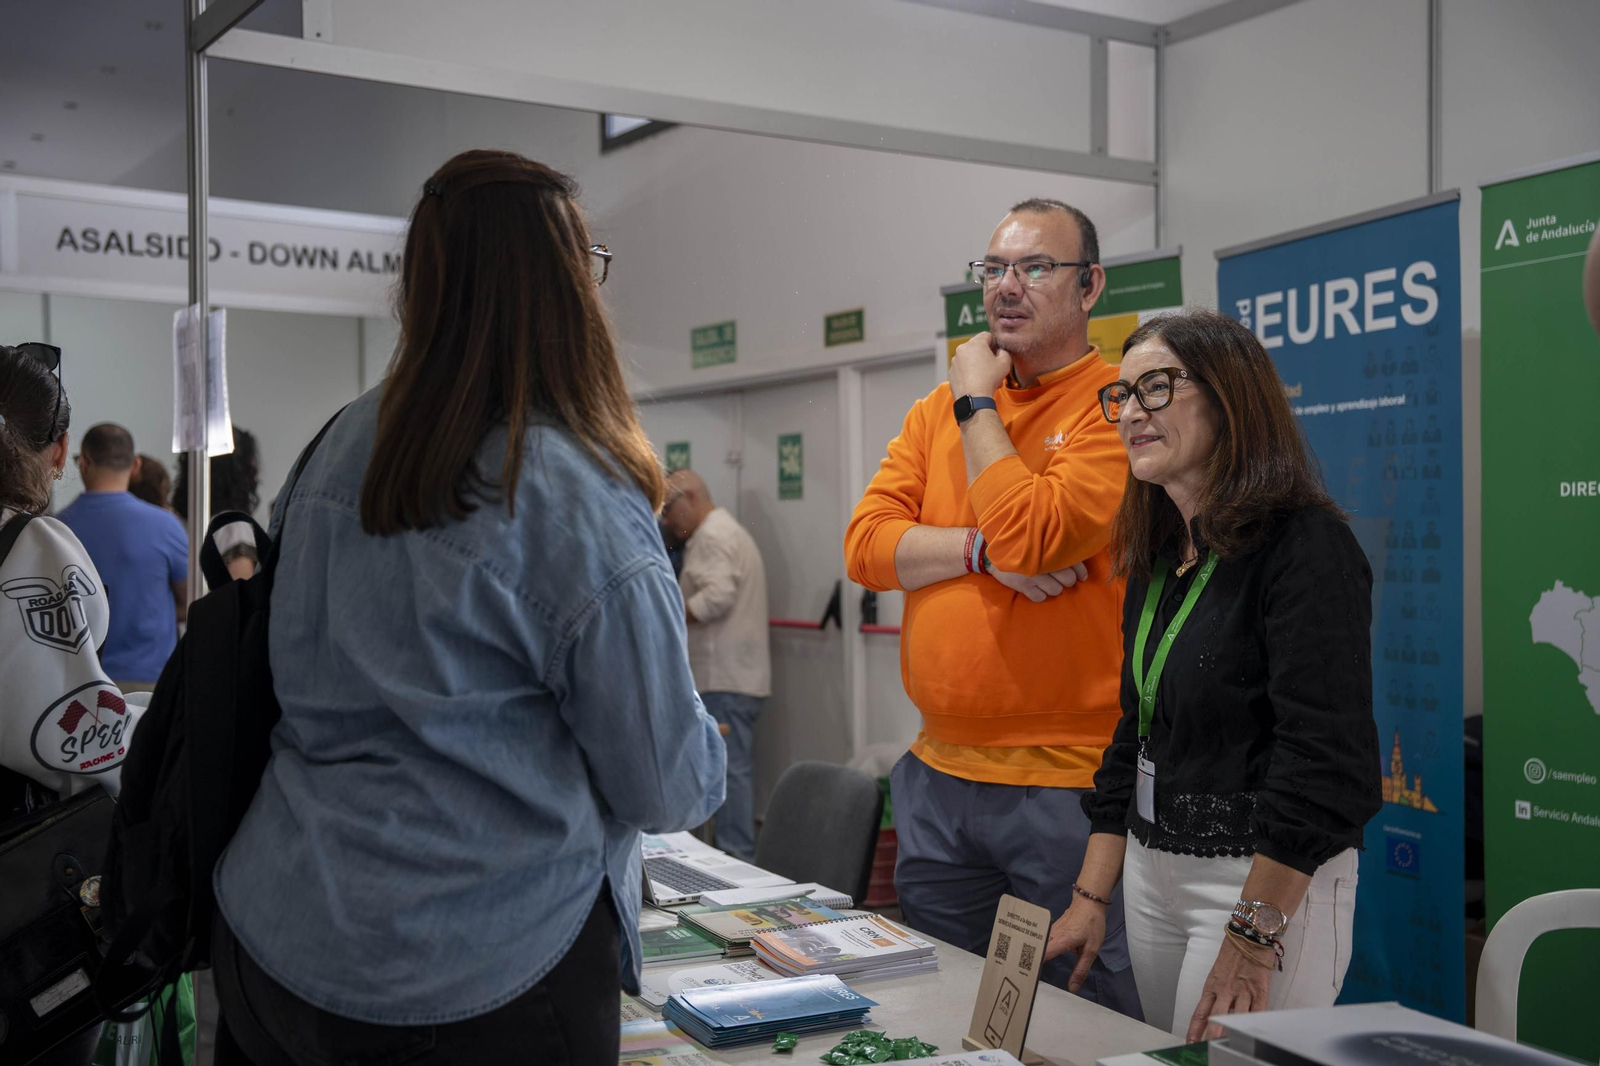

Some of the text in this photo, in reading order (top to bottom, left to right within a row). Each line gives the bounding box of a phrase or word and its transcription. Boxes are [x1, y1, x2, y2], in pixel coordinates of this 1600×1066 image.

[1526, 214, 1557, 230] Junta
[1525, 219, 1596, 244] de Andalucía
[248, 241, 339, 271] DOWN
[1255, 260, 1439, 349] EURES
[1379, 393, 1406, 407] laboral
[28, 591, 63, 608] ROAD
[1533, 805, 1570, 822] Servicio
[859, 926, 883, 940] CRN
